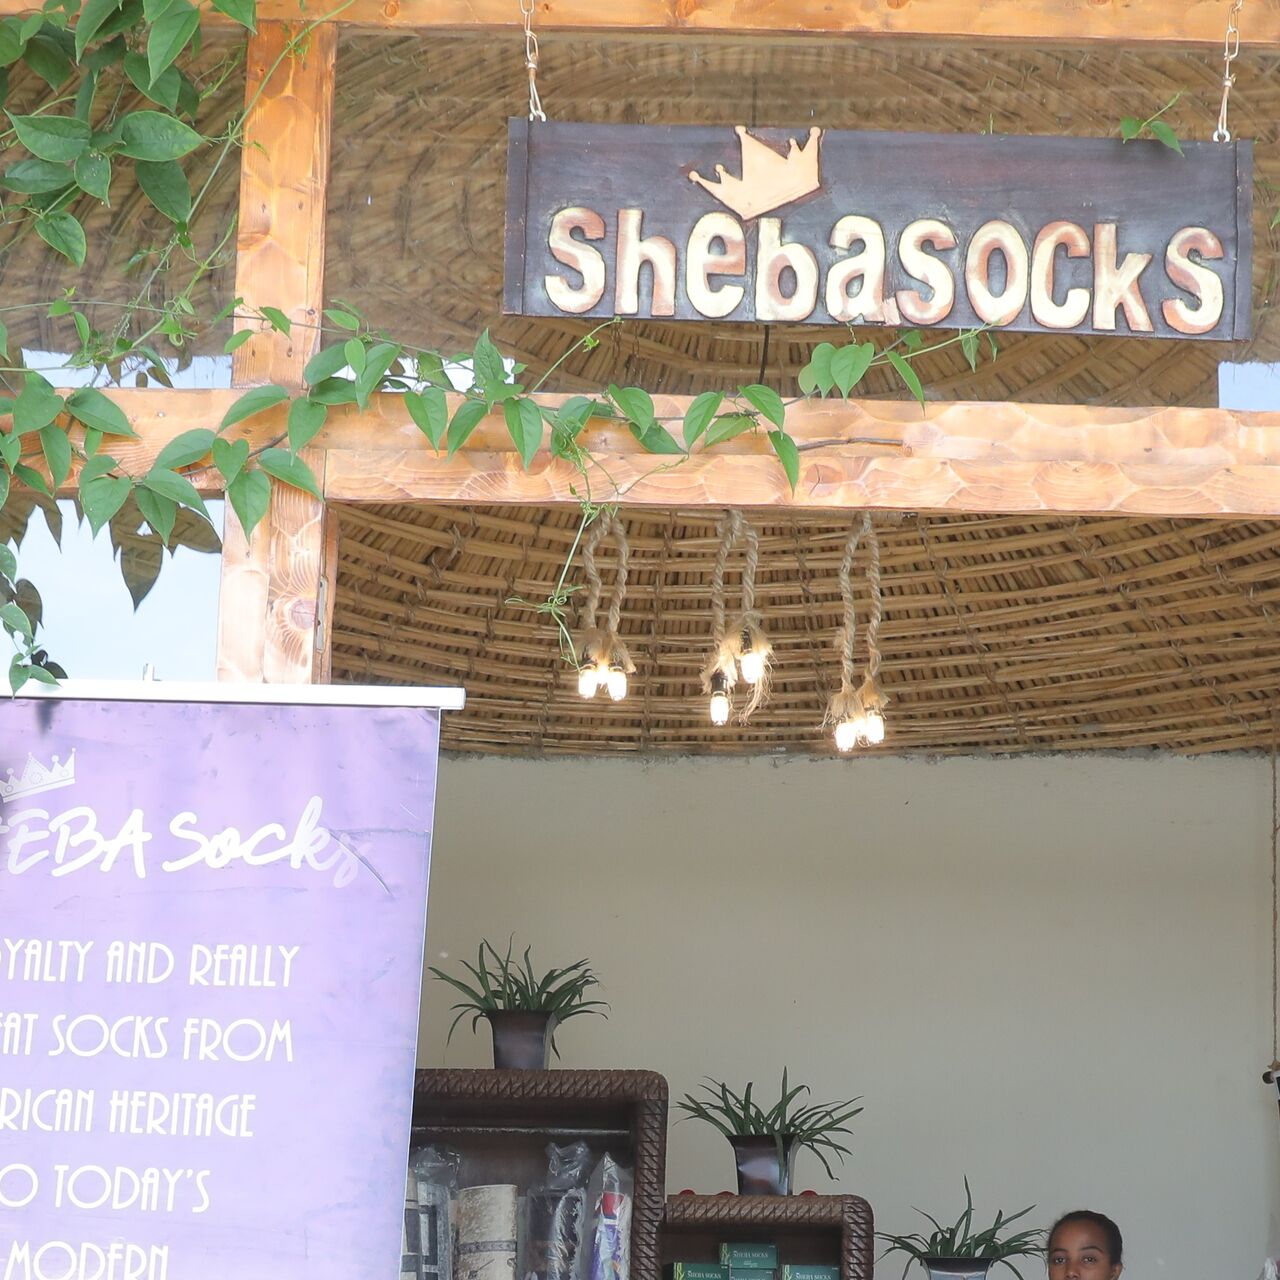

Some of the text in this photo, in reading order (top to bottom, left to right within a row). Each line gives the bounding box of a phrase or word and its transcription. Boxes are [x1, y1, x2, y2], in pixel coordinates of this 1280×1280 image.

[163, 795, 372, 888] Socks
[106, 942, 174, 984] AND
[189, 944, 300, 988] REALLY
[48, 1014, 168, 1060] SOCKS
[183, 1018, 294, 1063] FROM
[109, 1089, 256, 1138] HERITAGE
[53, 1165, 211, 1213] TODAY'S
